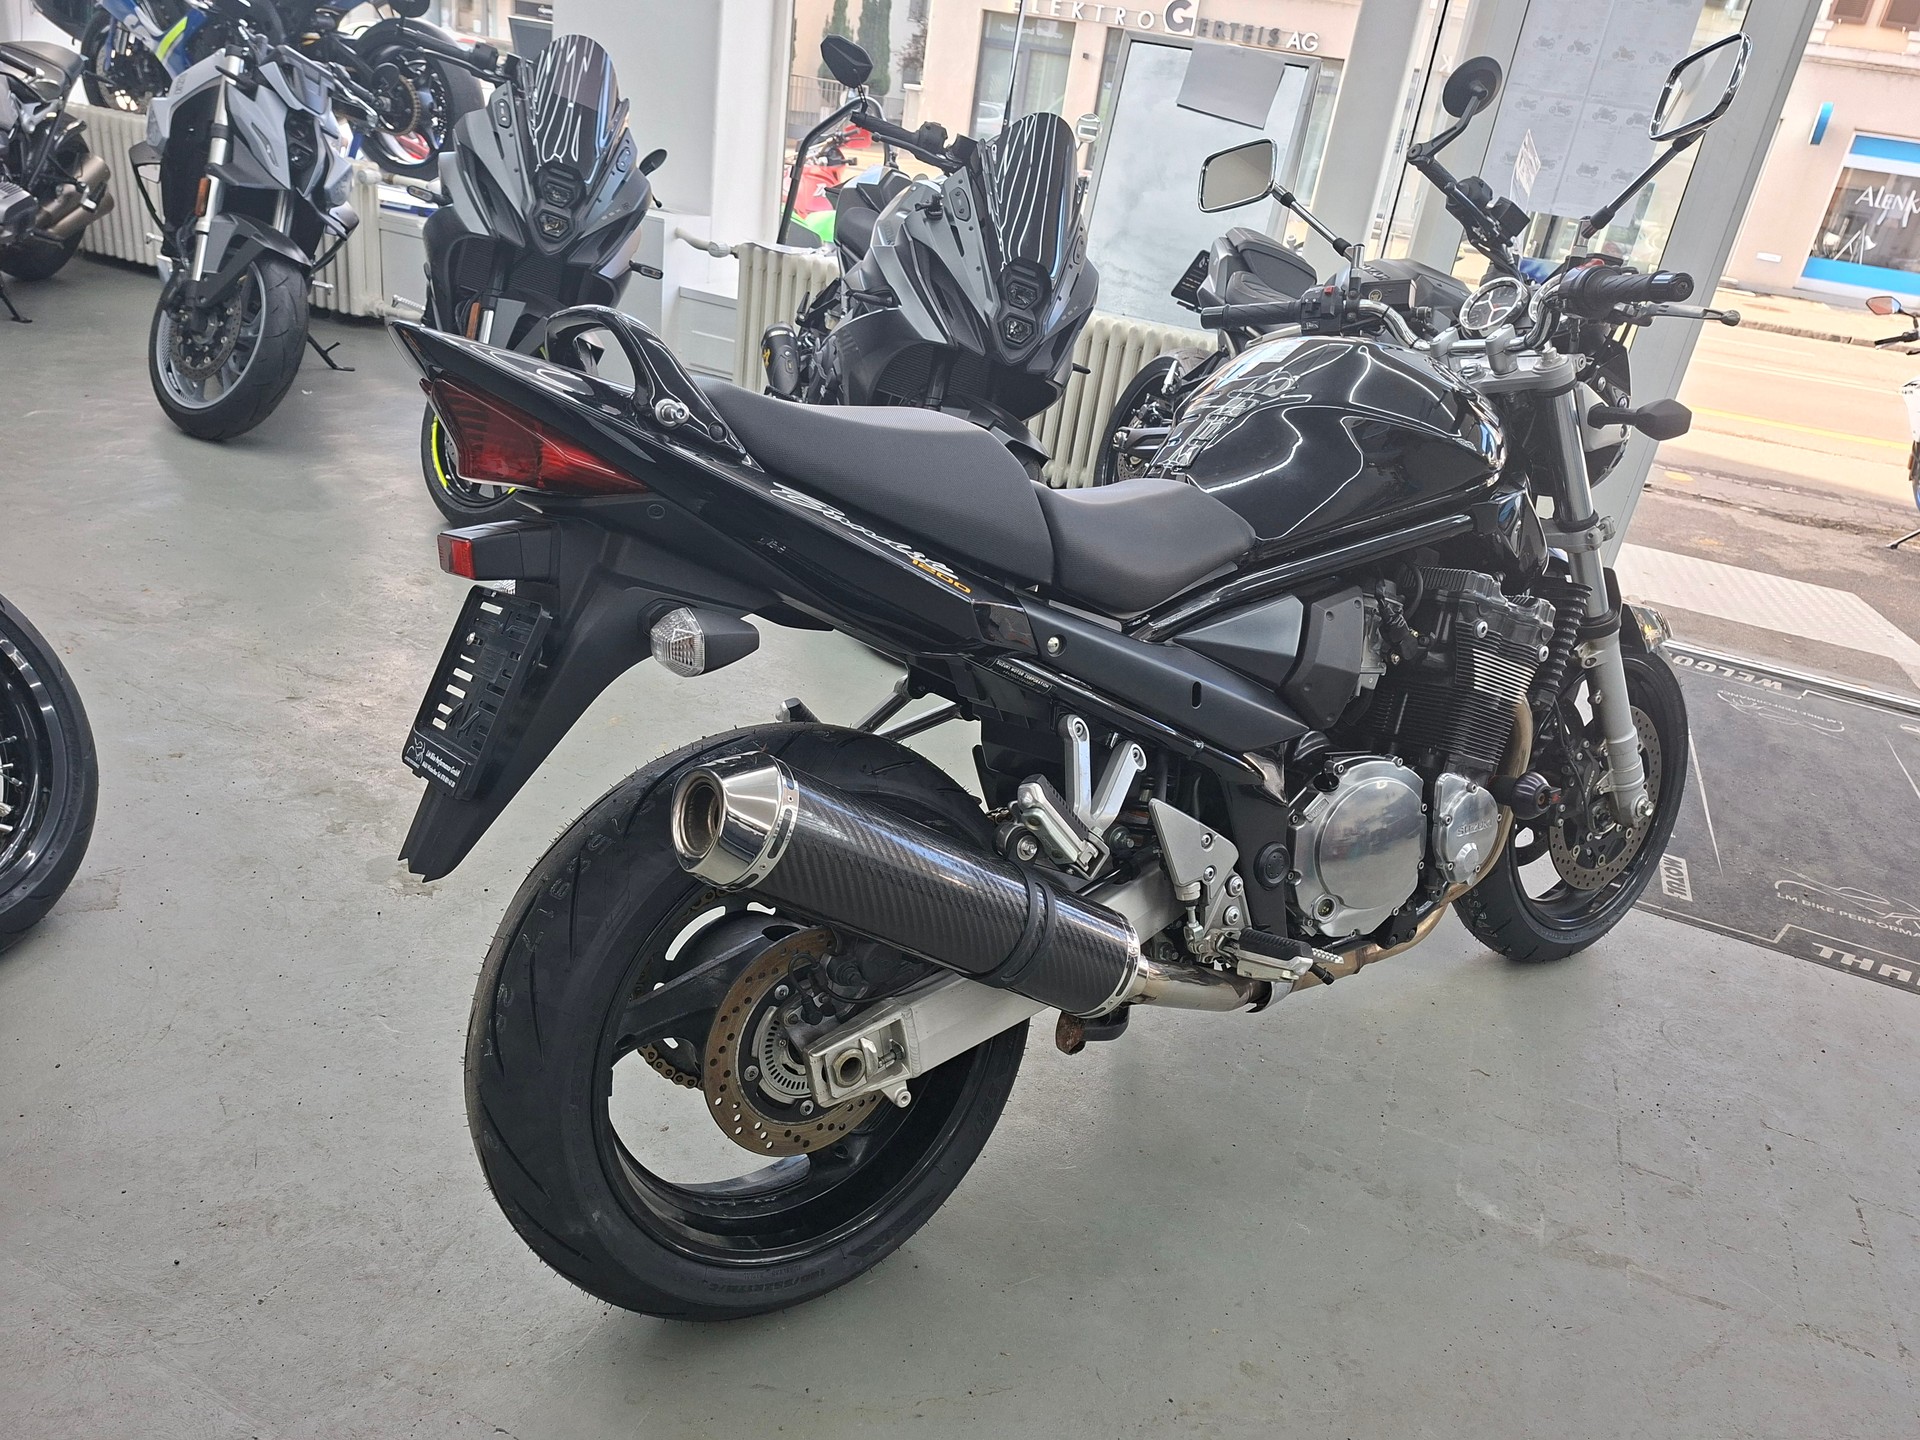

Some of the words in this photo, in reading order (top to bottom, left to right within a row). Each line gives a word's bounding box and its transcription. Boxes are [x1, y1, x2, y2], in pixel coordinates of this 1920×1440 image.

[1286, 30, 1319, 52] AG
[911, 558, 972, 594] 1200
[1669, 652, 1782, 690] WELCO
[1777, 892, 1798, 903] LM
[1801, 899, 1835, 914] BIKE
[1812, 941, 1920, 987] THA
